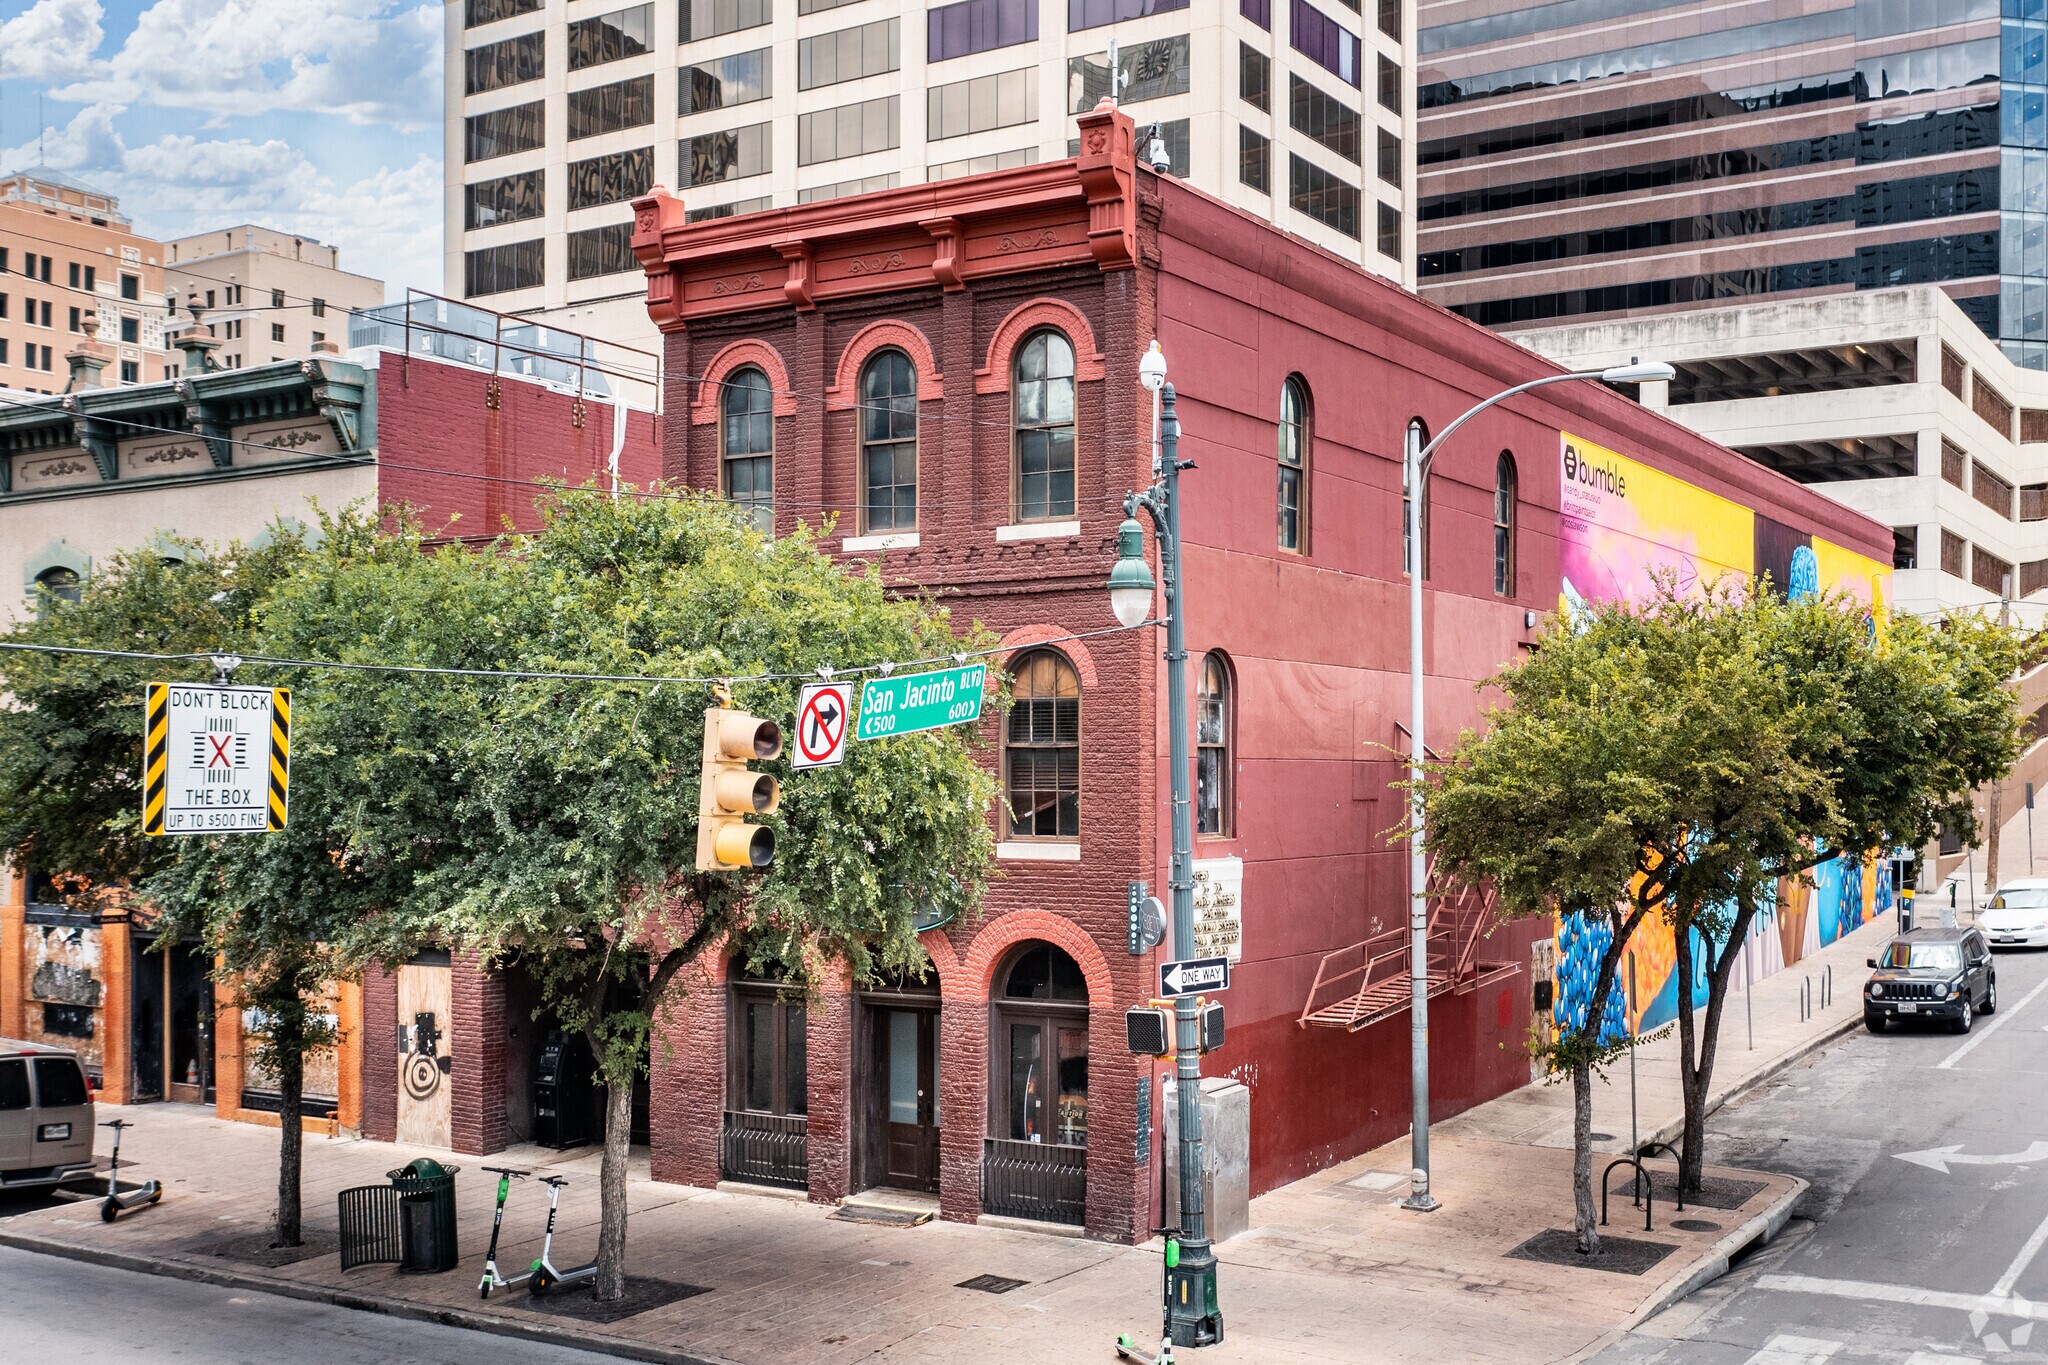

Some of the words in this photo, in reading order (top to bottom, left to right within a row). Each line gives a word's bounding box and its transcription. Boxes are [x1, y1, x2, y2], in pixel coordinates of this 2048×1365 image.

[1579, 449, 1626, 498] bumble
[172, 691, 214, 708] DON'T
[220, 693, 268, 710] BLOCK
[864, 686, 894, 715] San
[900, 676, 955, 710] Jacinto
[960, 669, 983, 690] BLVD
[948, 703, 968, 720] 600
[874, 714, 896, 732] 500
[186, 789, 214, 805] THE
[222, 789, 251, 804] BOX
[169, 814, 183, 827] UP
[190, 814, 204, 827] TO
[208, 813, 236, 827] $500
[240, 812, 264, 826] FINE
[1181, 970, 1200, 984] ONE
[1202, 968, 1221, 981] WAY
